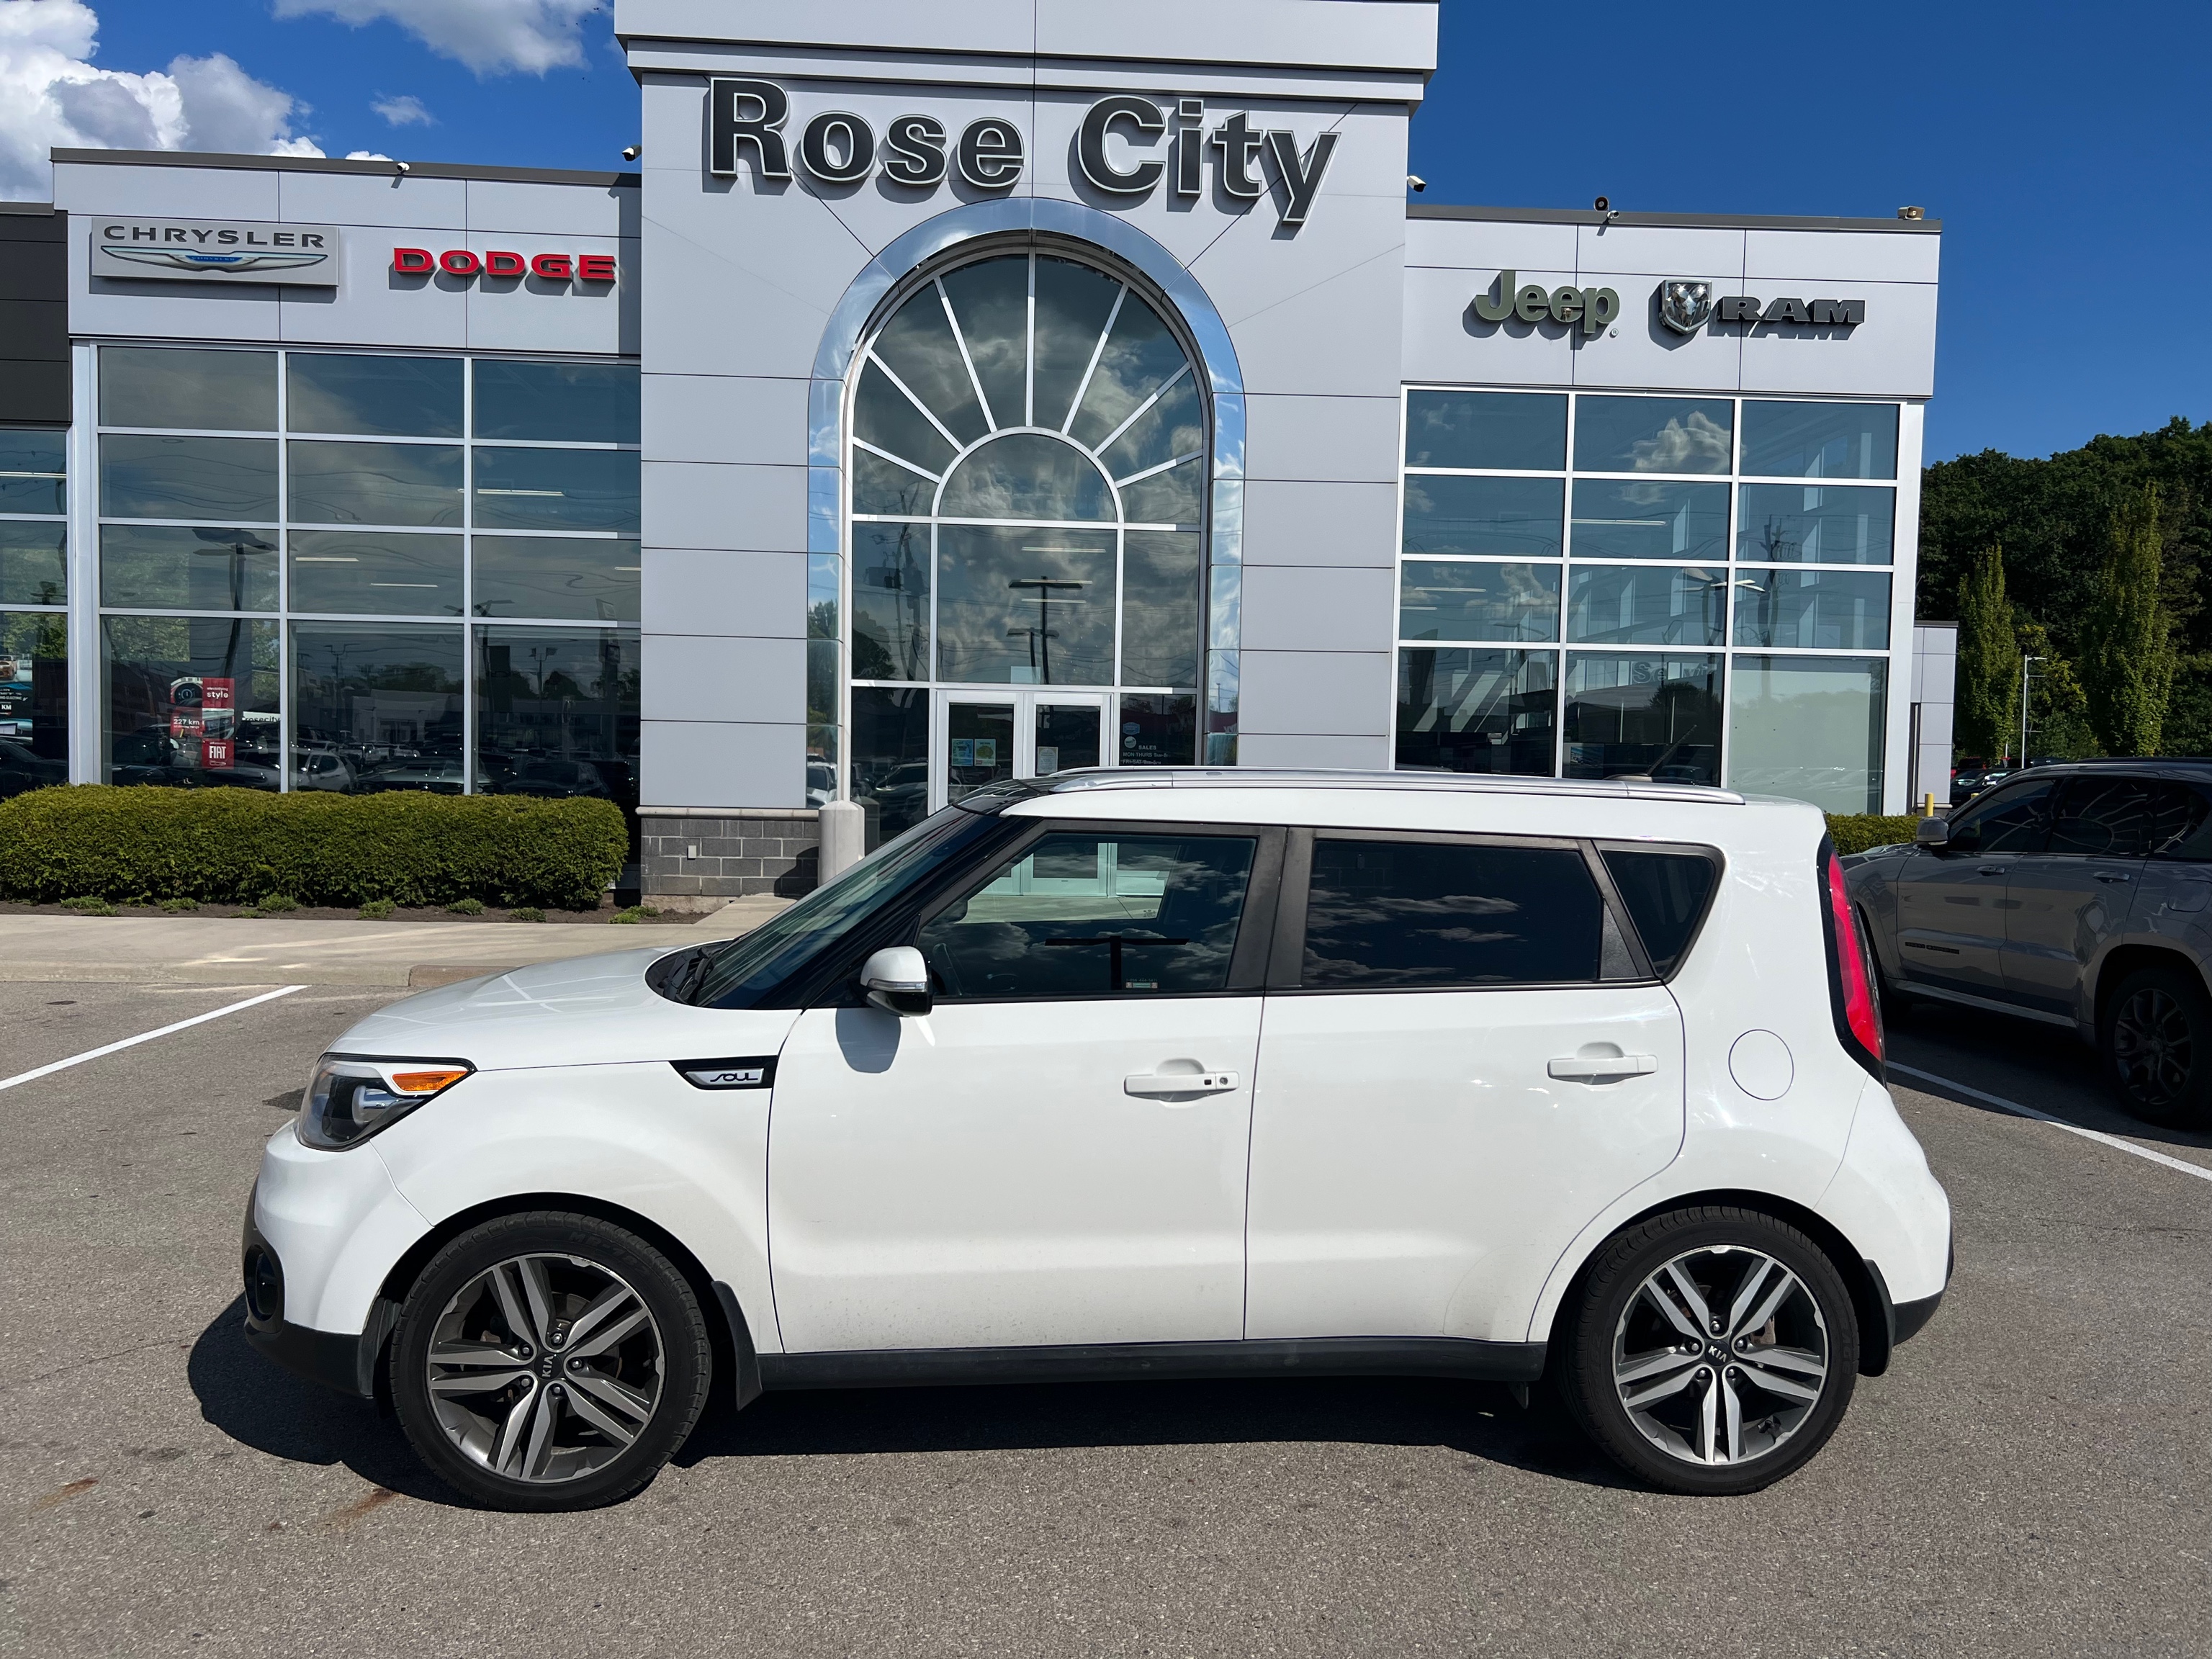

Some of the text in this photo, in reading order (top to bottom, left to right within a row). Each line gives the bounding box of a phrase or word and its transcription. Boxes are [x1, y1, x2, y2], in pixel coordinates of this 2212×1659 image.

[709, 76, 1341, 226] Rose City
[104, 225, 325, 249] CHRYSLER
[393, 248, 616, 280] DODGE
[1475, 269, 1620, 334] Jeep
[1717, 296, 1866, 324] RAM
[207, 691, 229, 699] style
[209, 745, 227, 759] FIAT
[710, 1072, 758, 1082] SOUL
[1707, 1345, 1727, 1363] KIA
[541, 1355, 554, 1377] KIA
